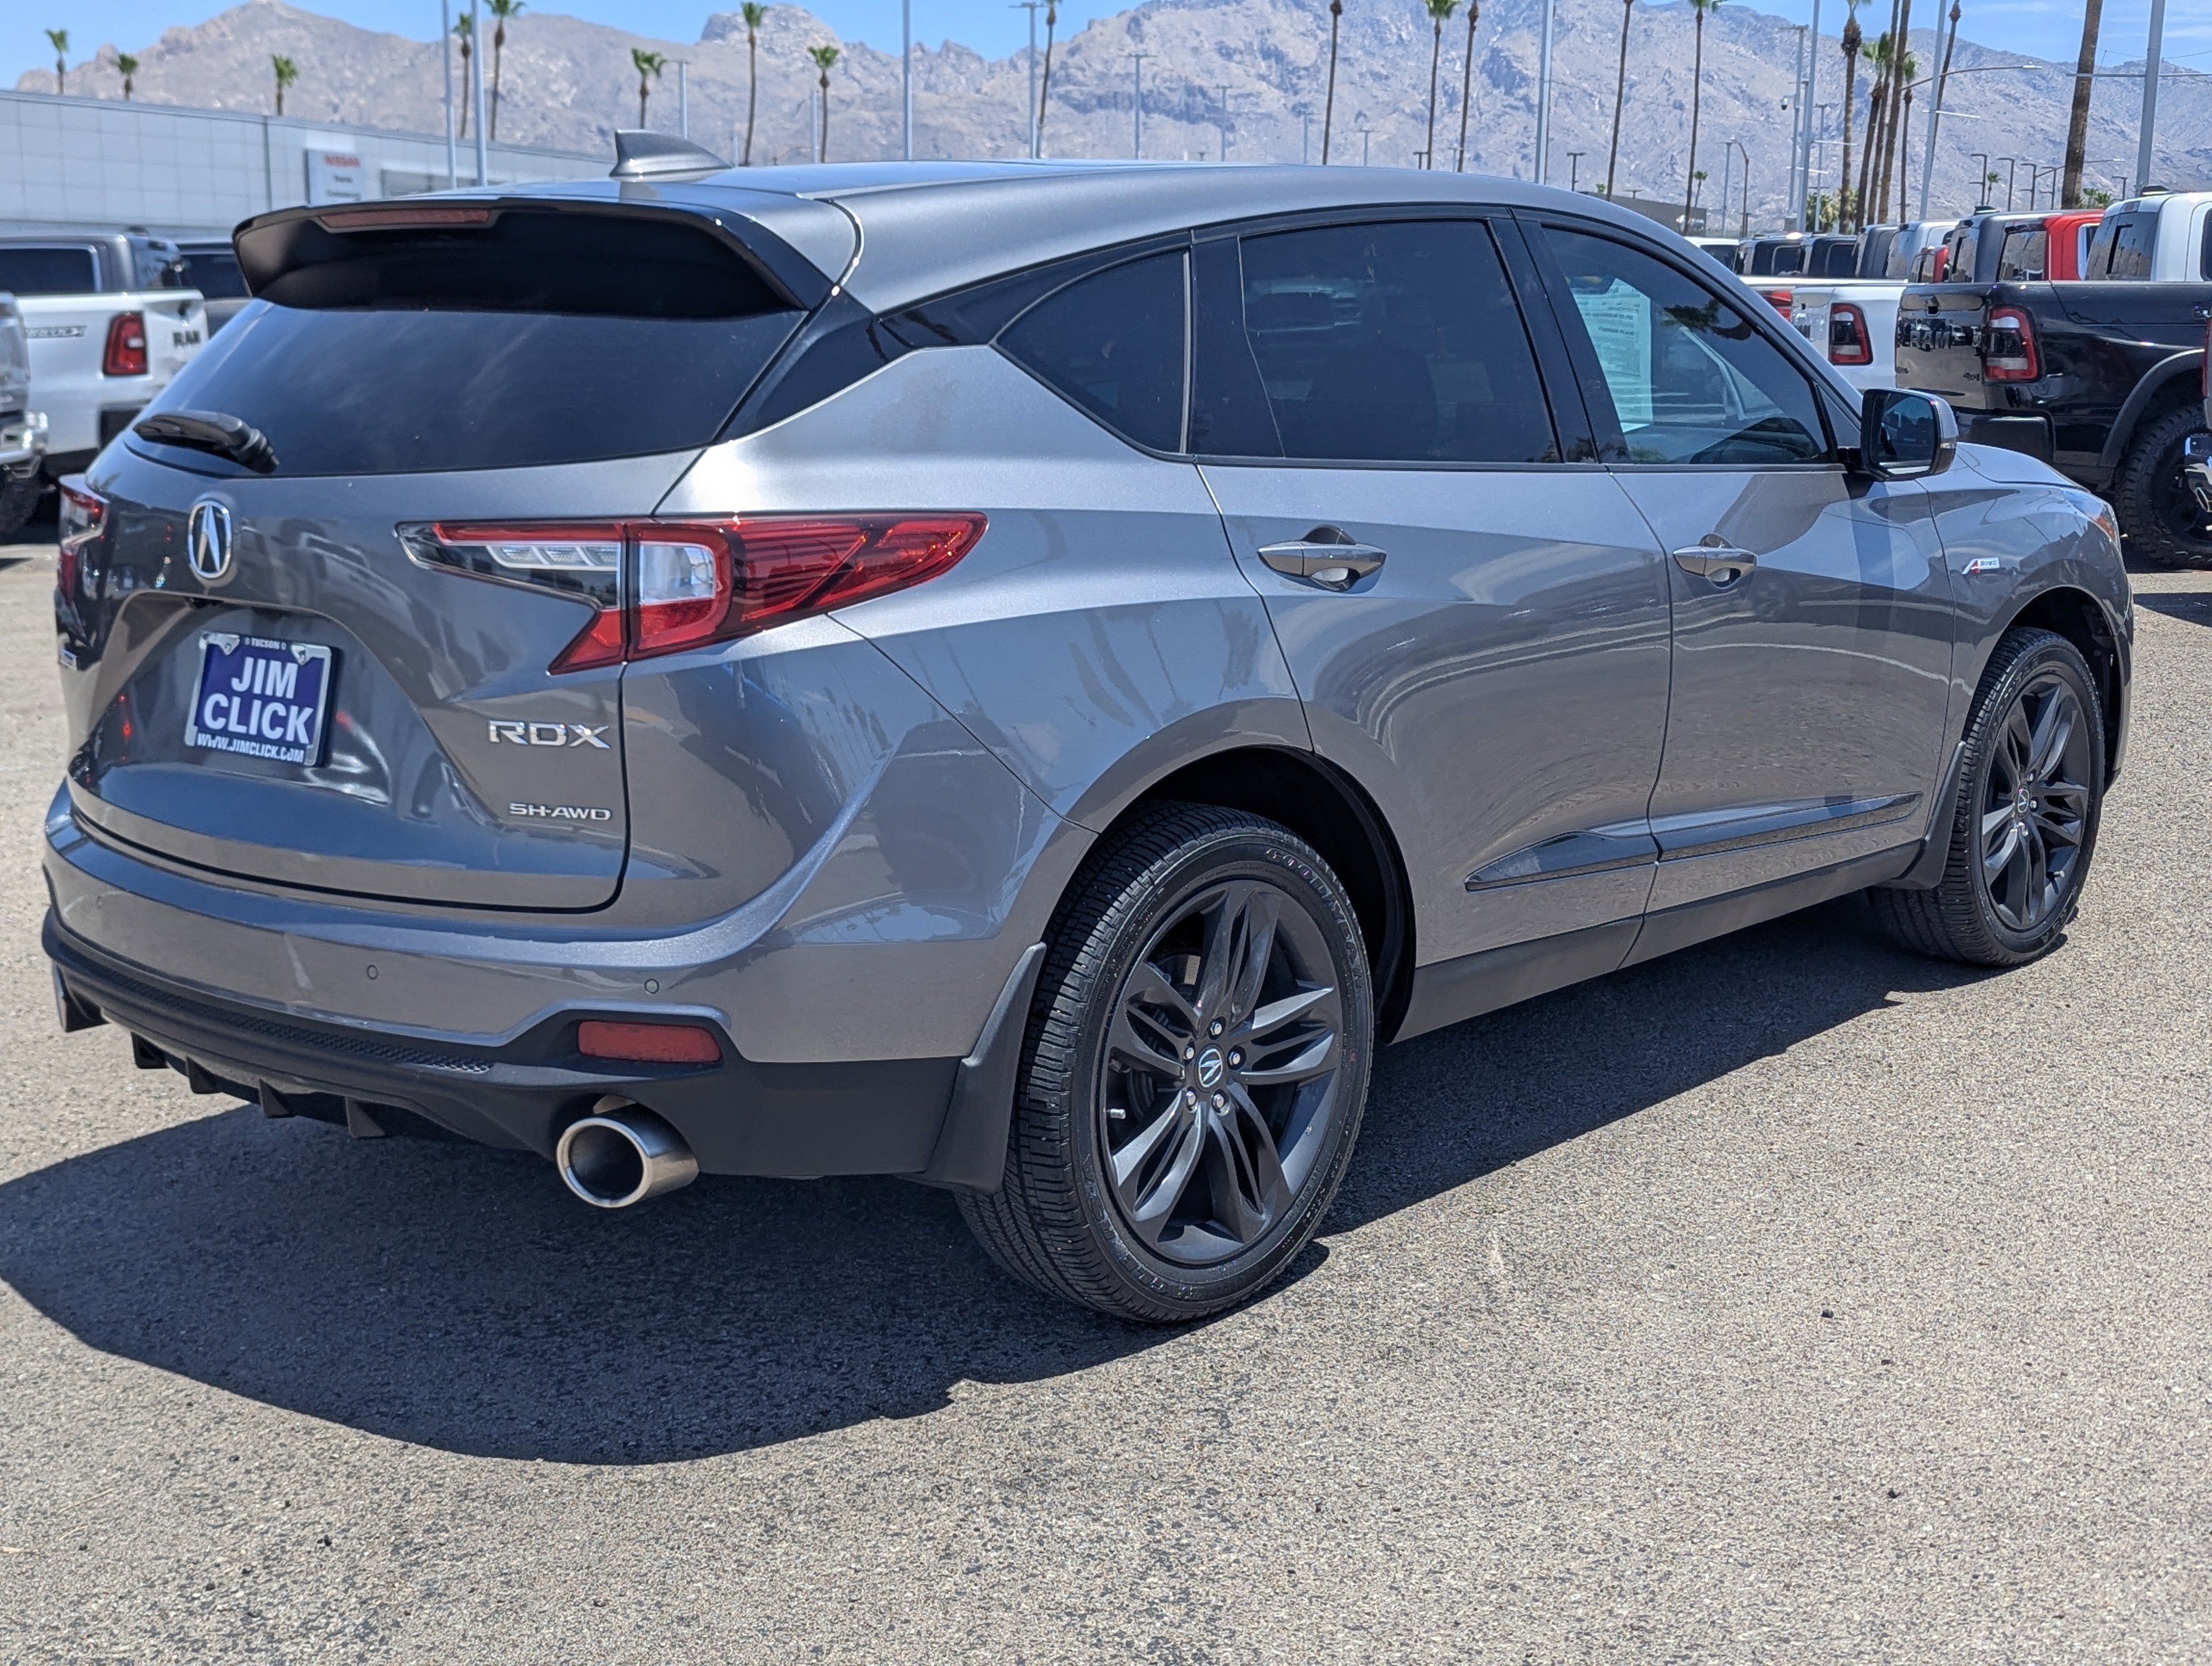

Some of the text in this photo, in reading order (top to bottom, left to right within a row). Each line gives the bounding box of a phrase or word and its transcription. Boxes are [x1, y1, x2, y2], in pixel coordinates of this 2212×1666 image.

[1910, 330, 1951, 349] RAM
[231, 656, 298, 699] JIM
[203, 693, 314, 745] CLICK
[196, 732, 305, 763] WWW.JIMCLICK.COM
[489, 720, 612, 749] RDX
[509, 803, 612, 821] SH-AWD
